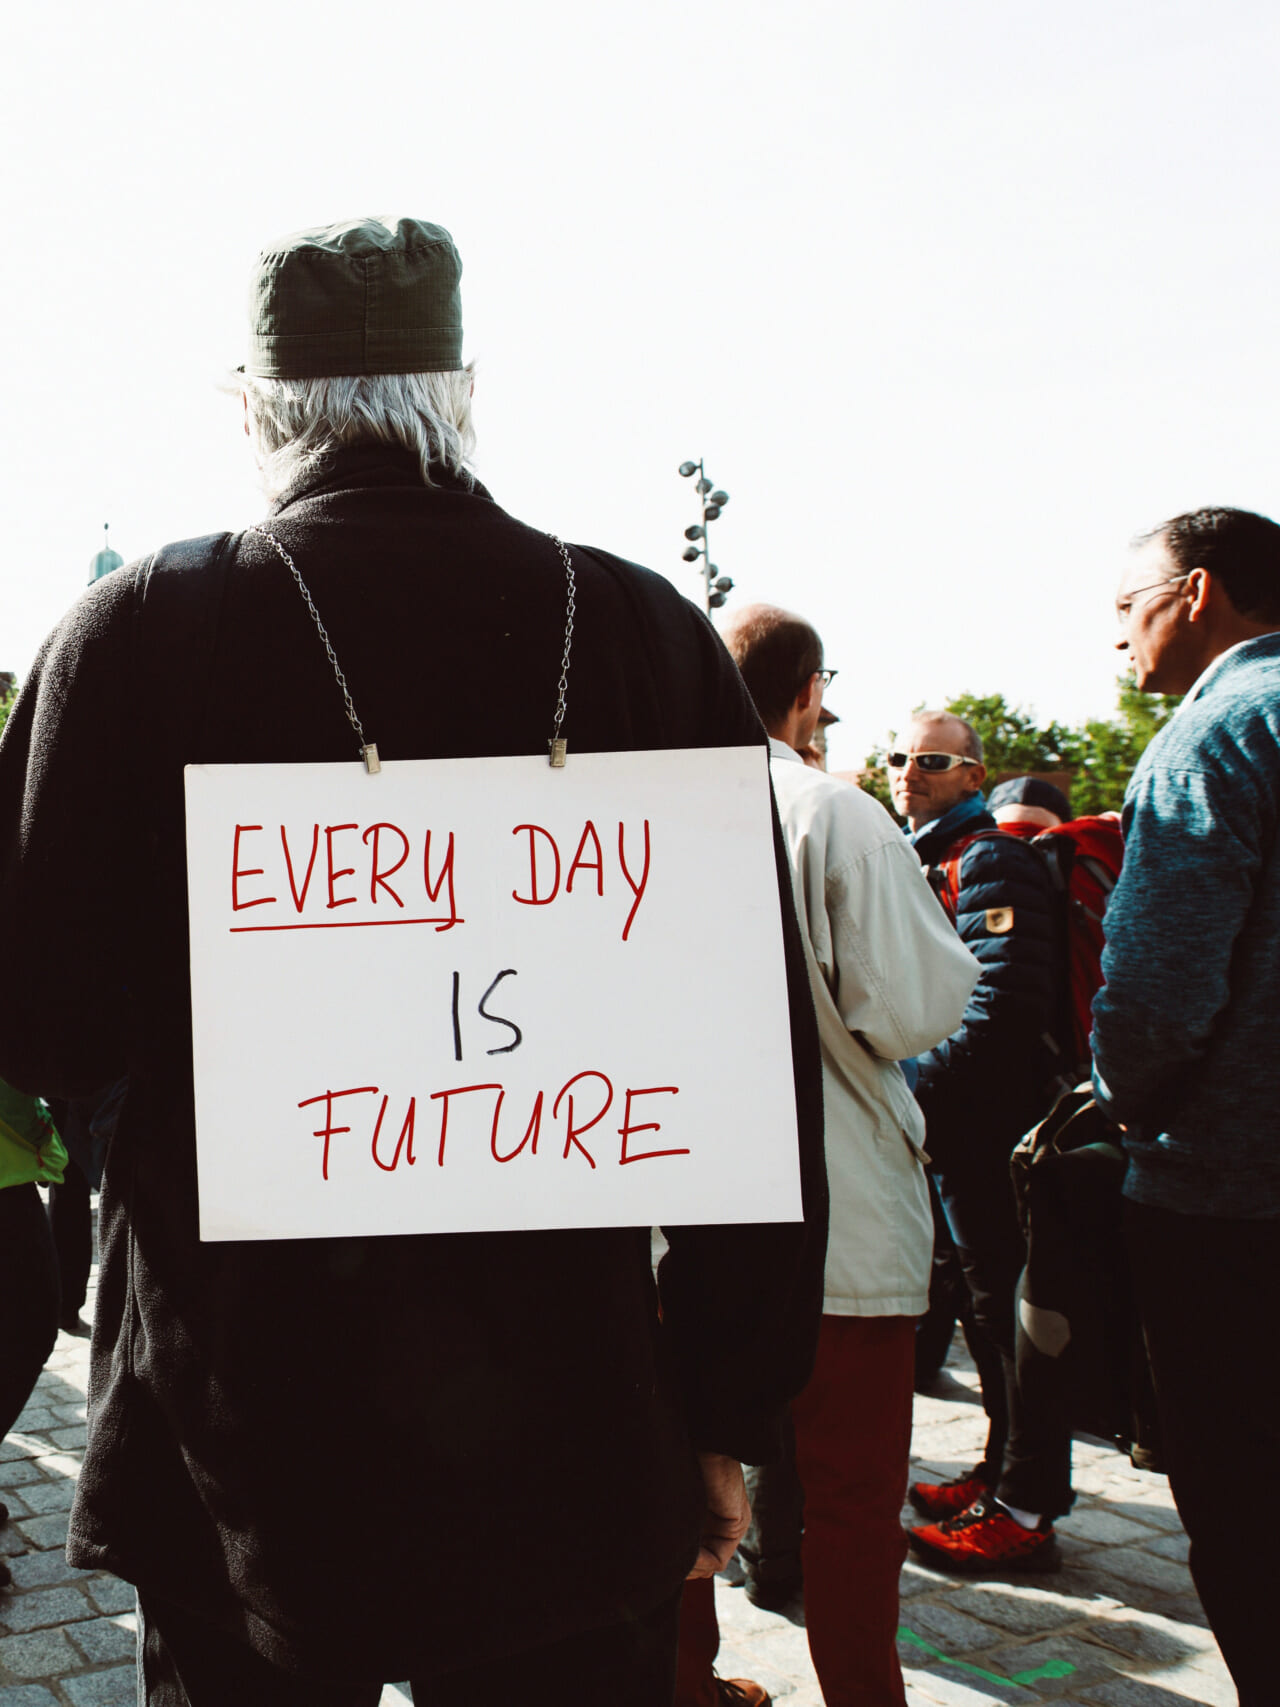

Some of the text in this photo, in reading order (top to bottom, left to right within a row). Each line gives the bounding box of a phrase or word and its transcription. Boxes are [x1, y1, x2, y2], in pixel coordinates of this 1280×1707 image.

[231, 819, 651, 941] EVERY DAY
[452, 968, 522, 1062] IS
[297, 1070, 691, 1181] FUTURE
